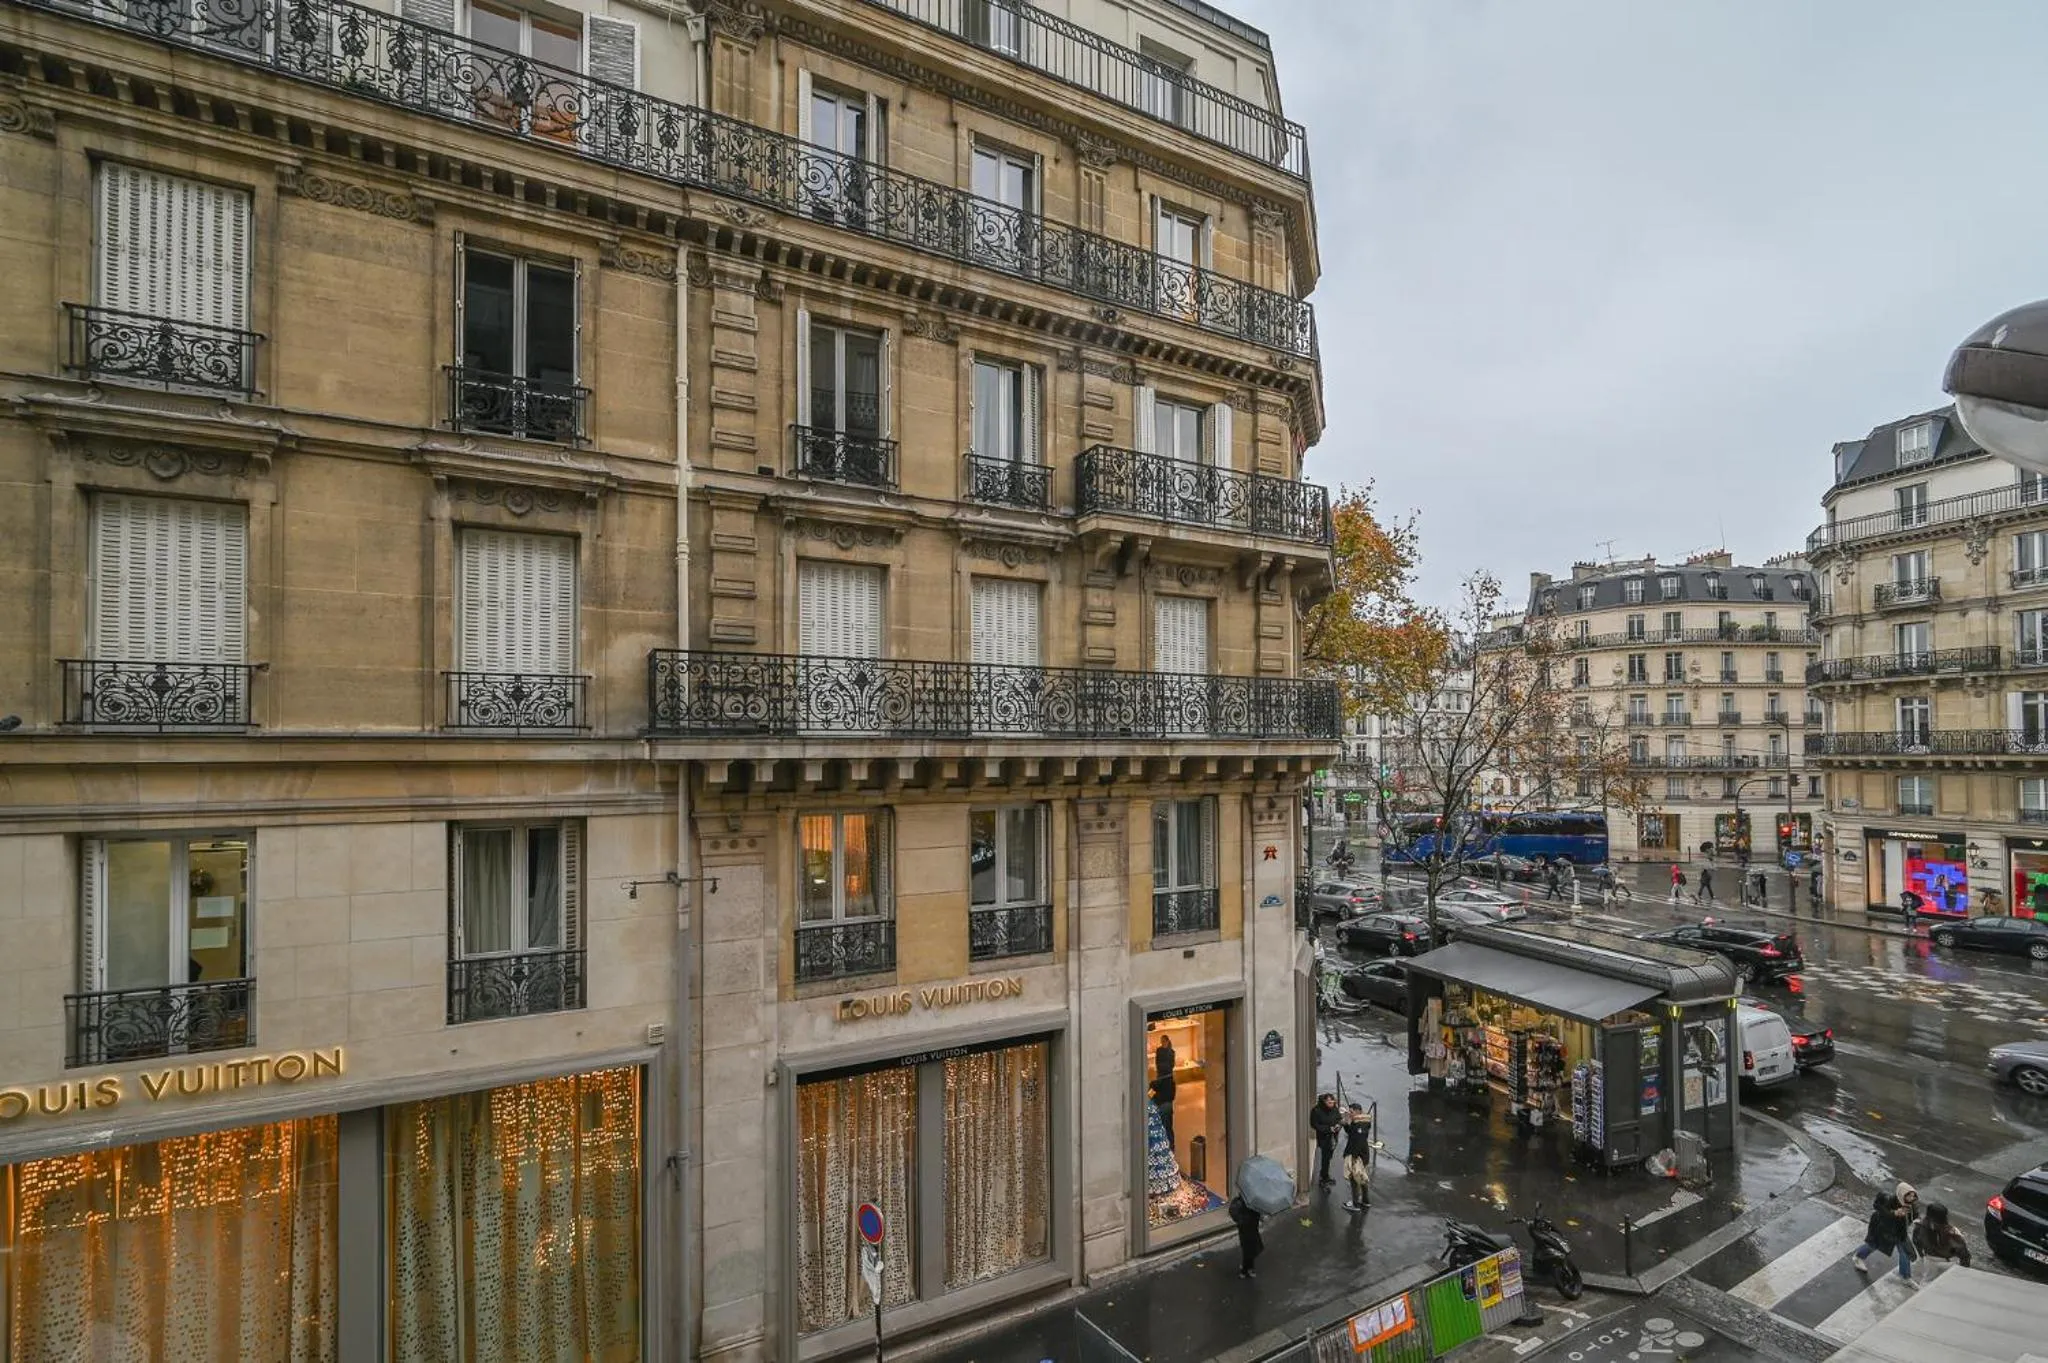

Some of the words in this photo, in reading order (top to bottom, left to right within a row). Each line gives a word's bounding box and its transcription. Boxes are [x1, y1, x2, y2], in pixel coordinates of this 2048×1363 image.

[835, 992, 912, 1021] LOUIS
[920, 976, 1023, 1009] VUITTON
[140, 1048, 343, 1101] VUITTON
[901, 1053, 928, 1066] LOUIS
[930, 1047, 968, 1060] VUITTON
[1568, 1327, 1631, 1361] MOTO
